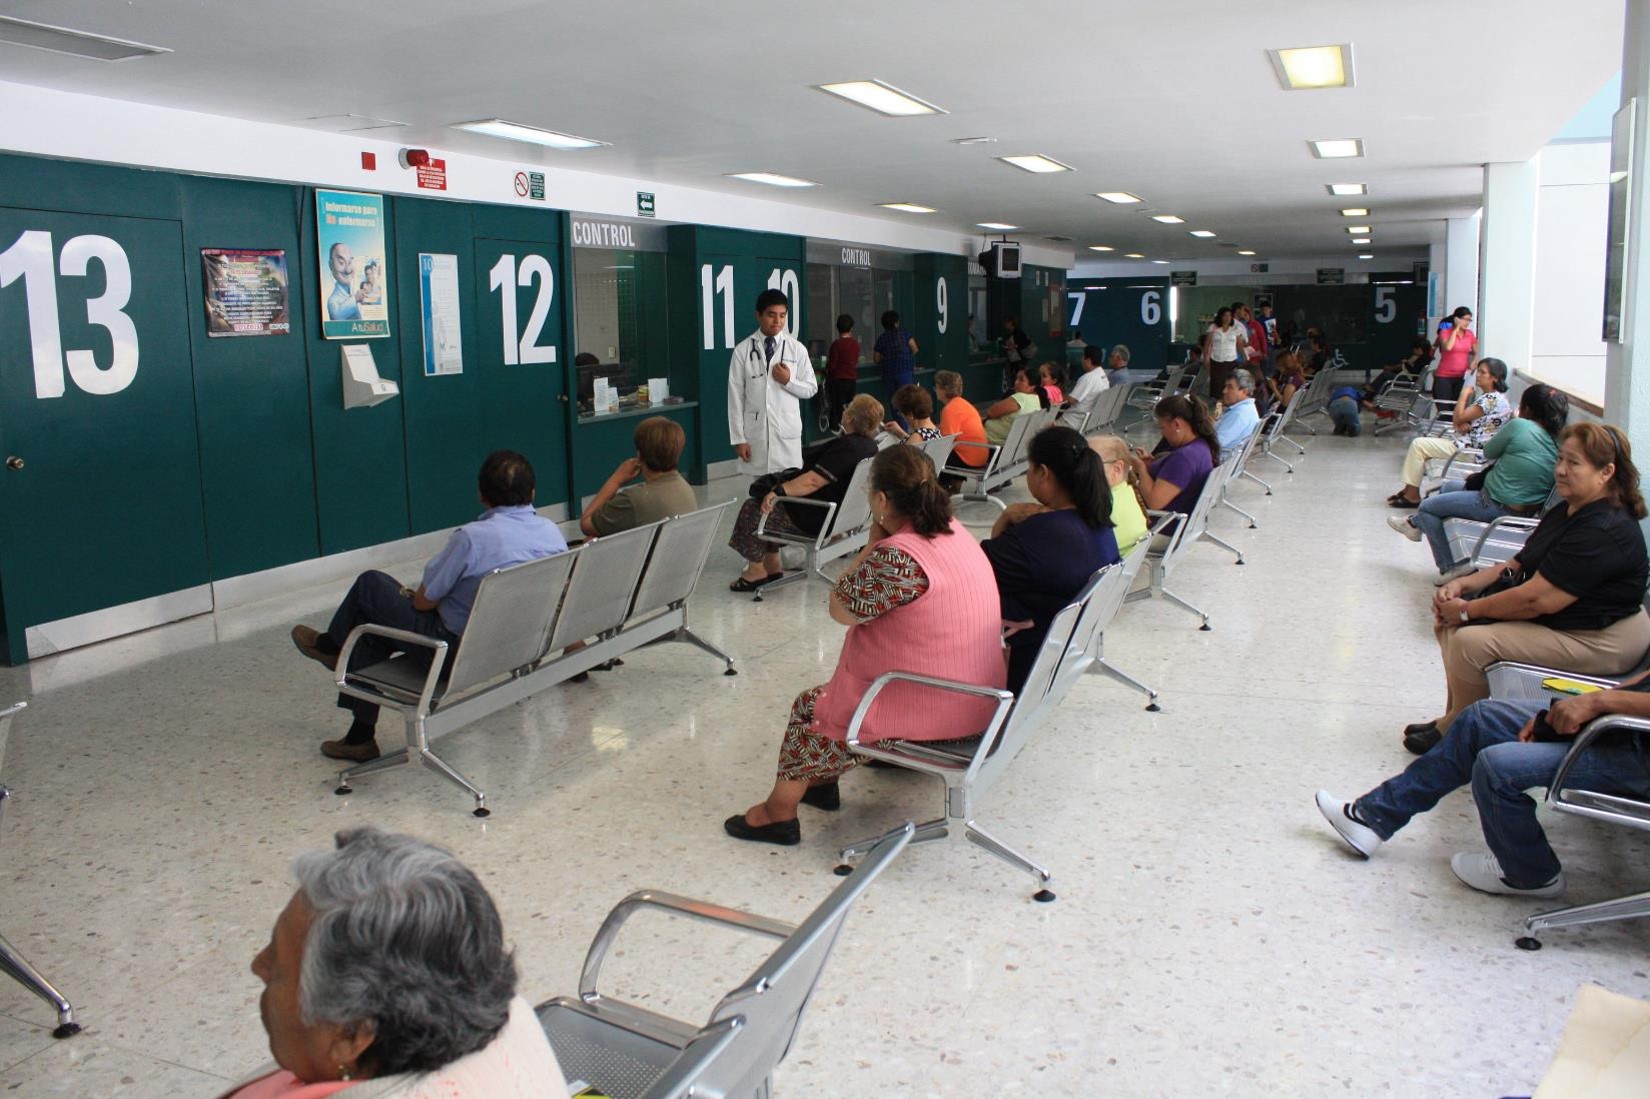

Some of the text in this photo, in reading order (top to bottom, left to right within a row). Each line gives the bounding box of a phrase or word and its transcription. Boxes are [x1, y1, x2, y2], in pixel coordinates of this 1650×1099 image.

[572, 221, 636, 247] CONTROL
[841, 247, 871, 266] CONTROL
[0, 230, 139, 398] 13
[489, 254, 557, 366] 12
[701, 263, 736, 350] 11
[937, 276, 948, 334] 9
[1067, 292, 1086, 326] 7
[1141, 291, 1161, 324] 6
[1376, 287, 1396, 323] 5
